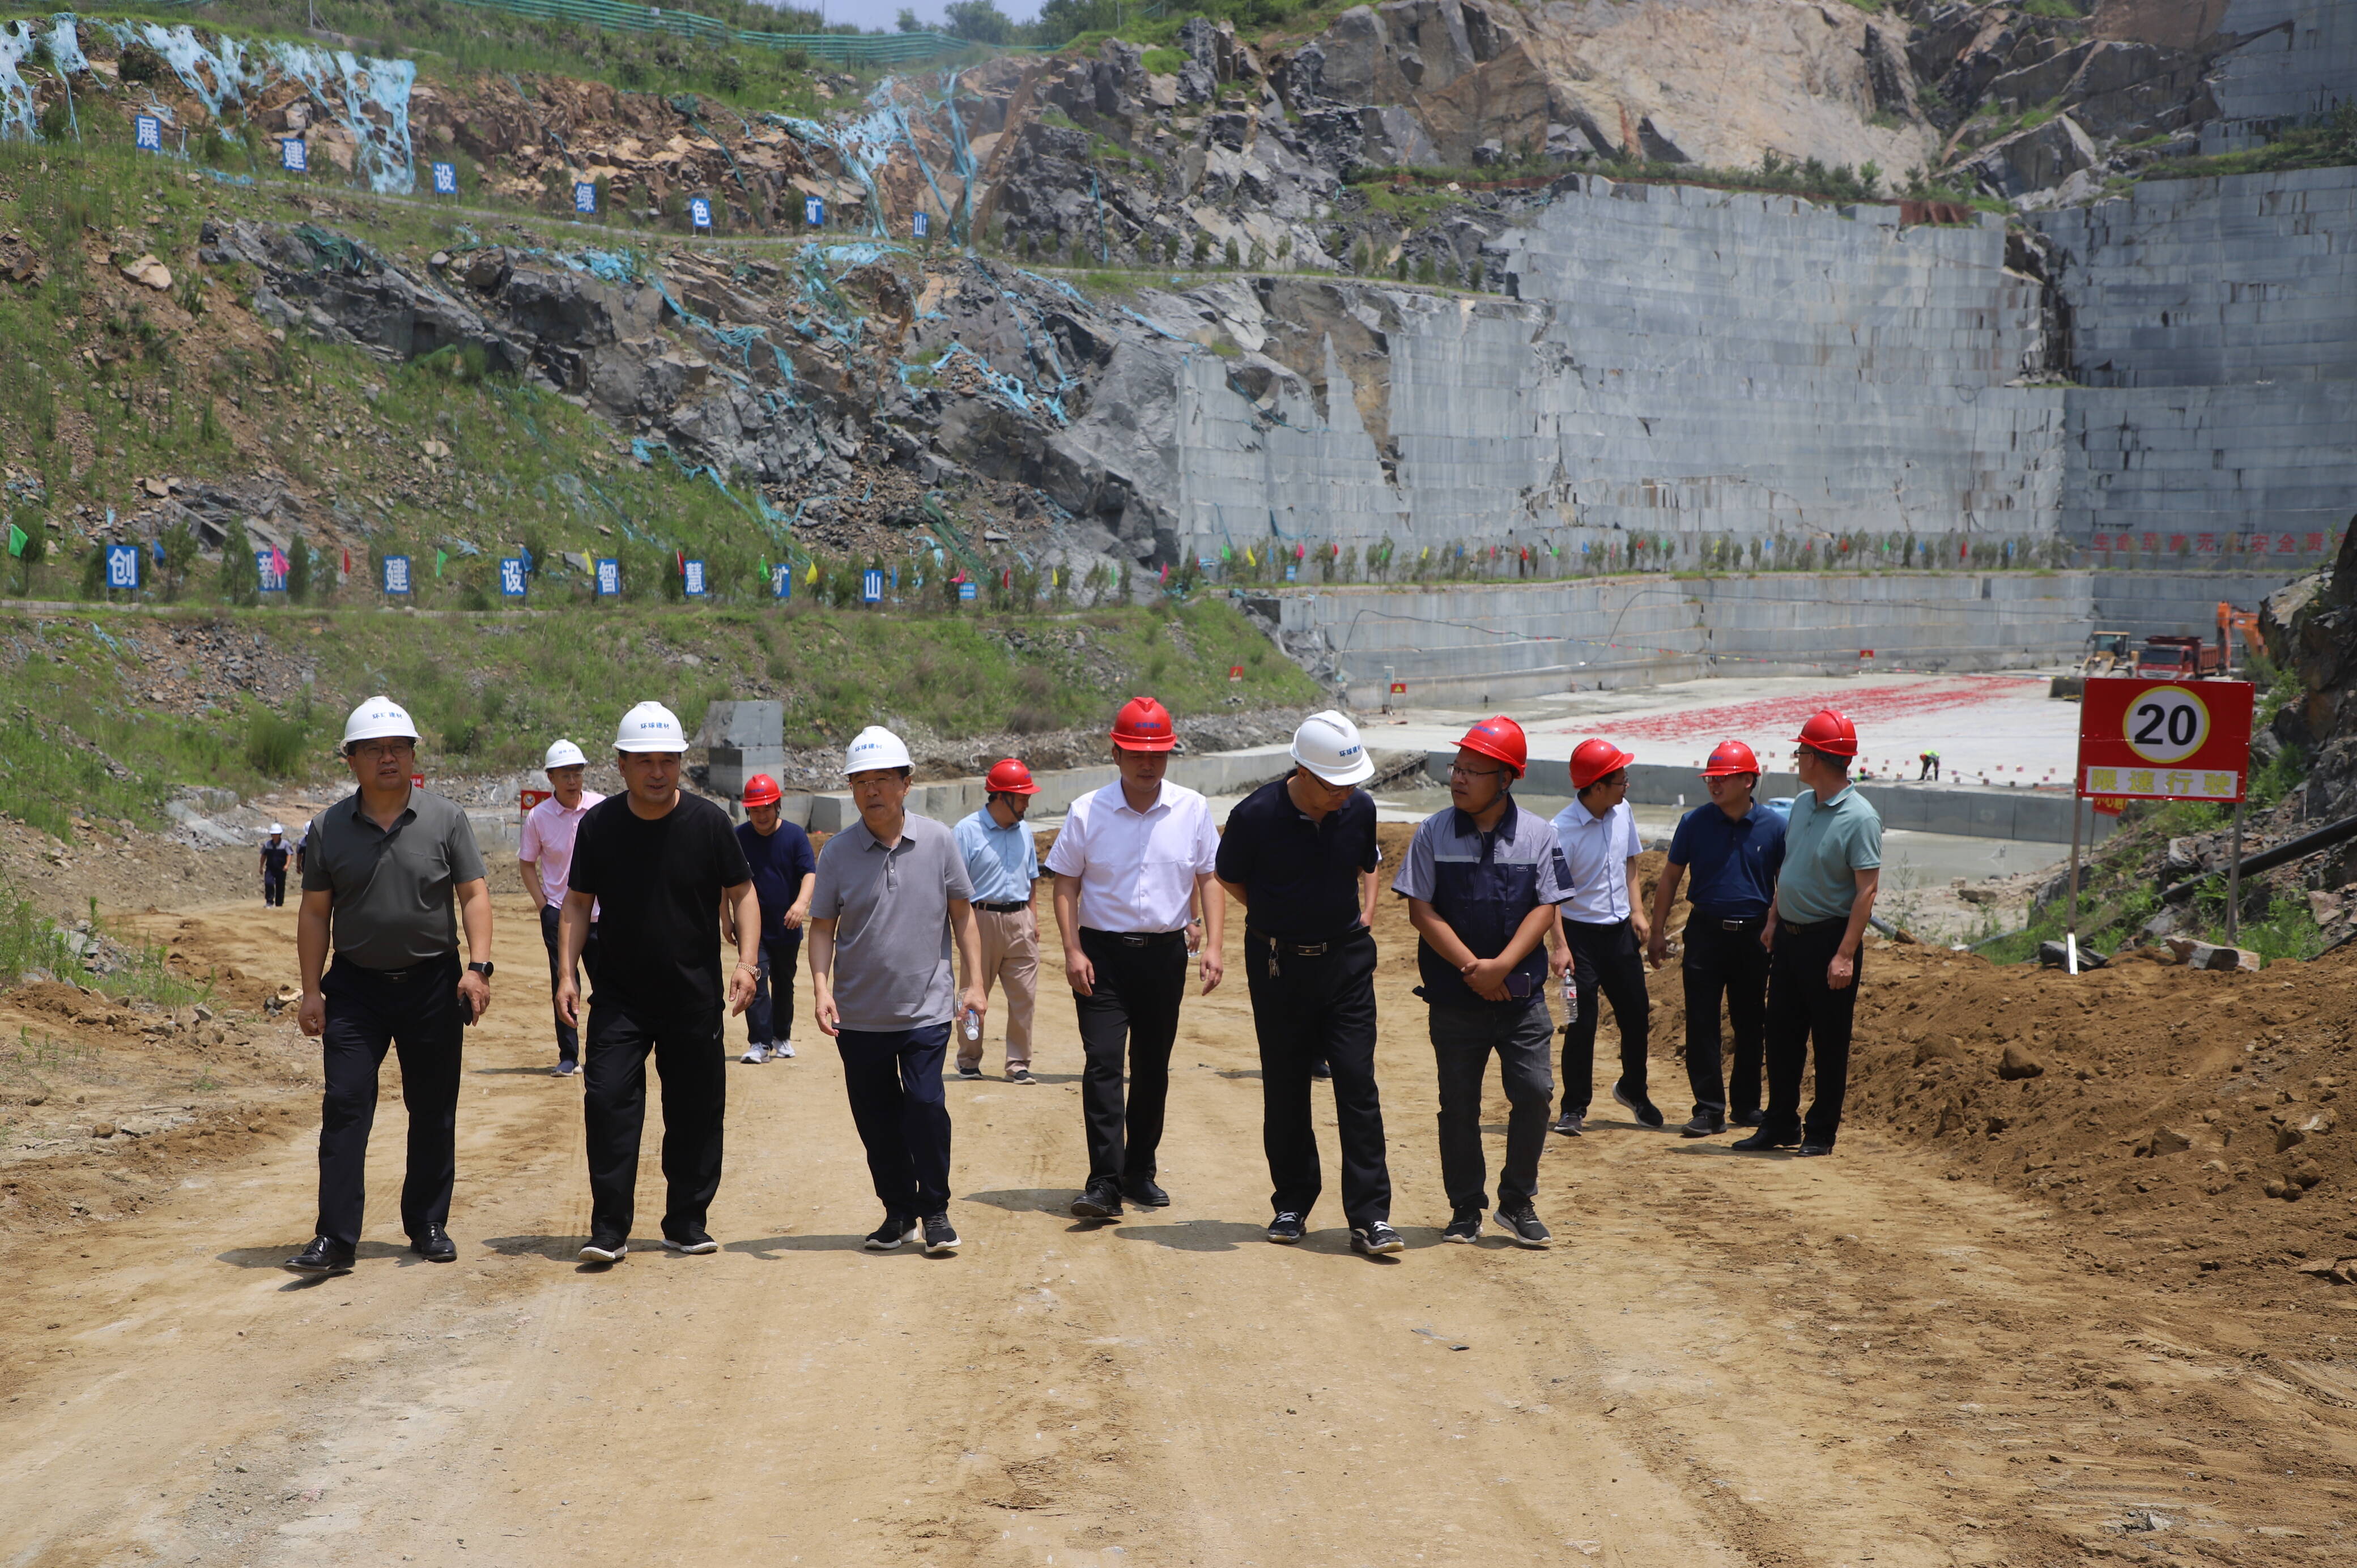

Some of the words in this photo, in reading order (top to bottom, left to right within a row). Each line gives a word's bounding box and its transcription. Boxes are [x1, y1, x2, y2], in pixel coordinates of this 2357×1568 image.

[137, 118, 160, 148] 展
[284, 142, 305, 169] 建
[435, 165, 454, 191] 设
[577, 183, 594, 211] 绿
[692, 200, 710, 224] 色
[807, 199, 822, 221] 矿
[914, 215, 926, 235] 山
[109, 548, 135, 586] 创
[386, 559, 407, 591] 建
[503, 561, 524, 593] 设
[598, 561, 616, 593] 智
[686, 563, 703, 593] 慧
[866, 573, 880, 599] 山
[2134, 703, 2197, 746] 20
[2091, 769, 2231, 795] 限速行驶
